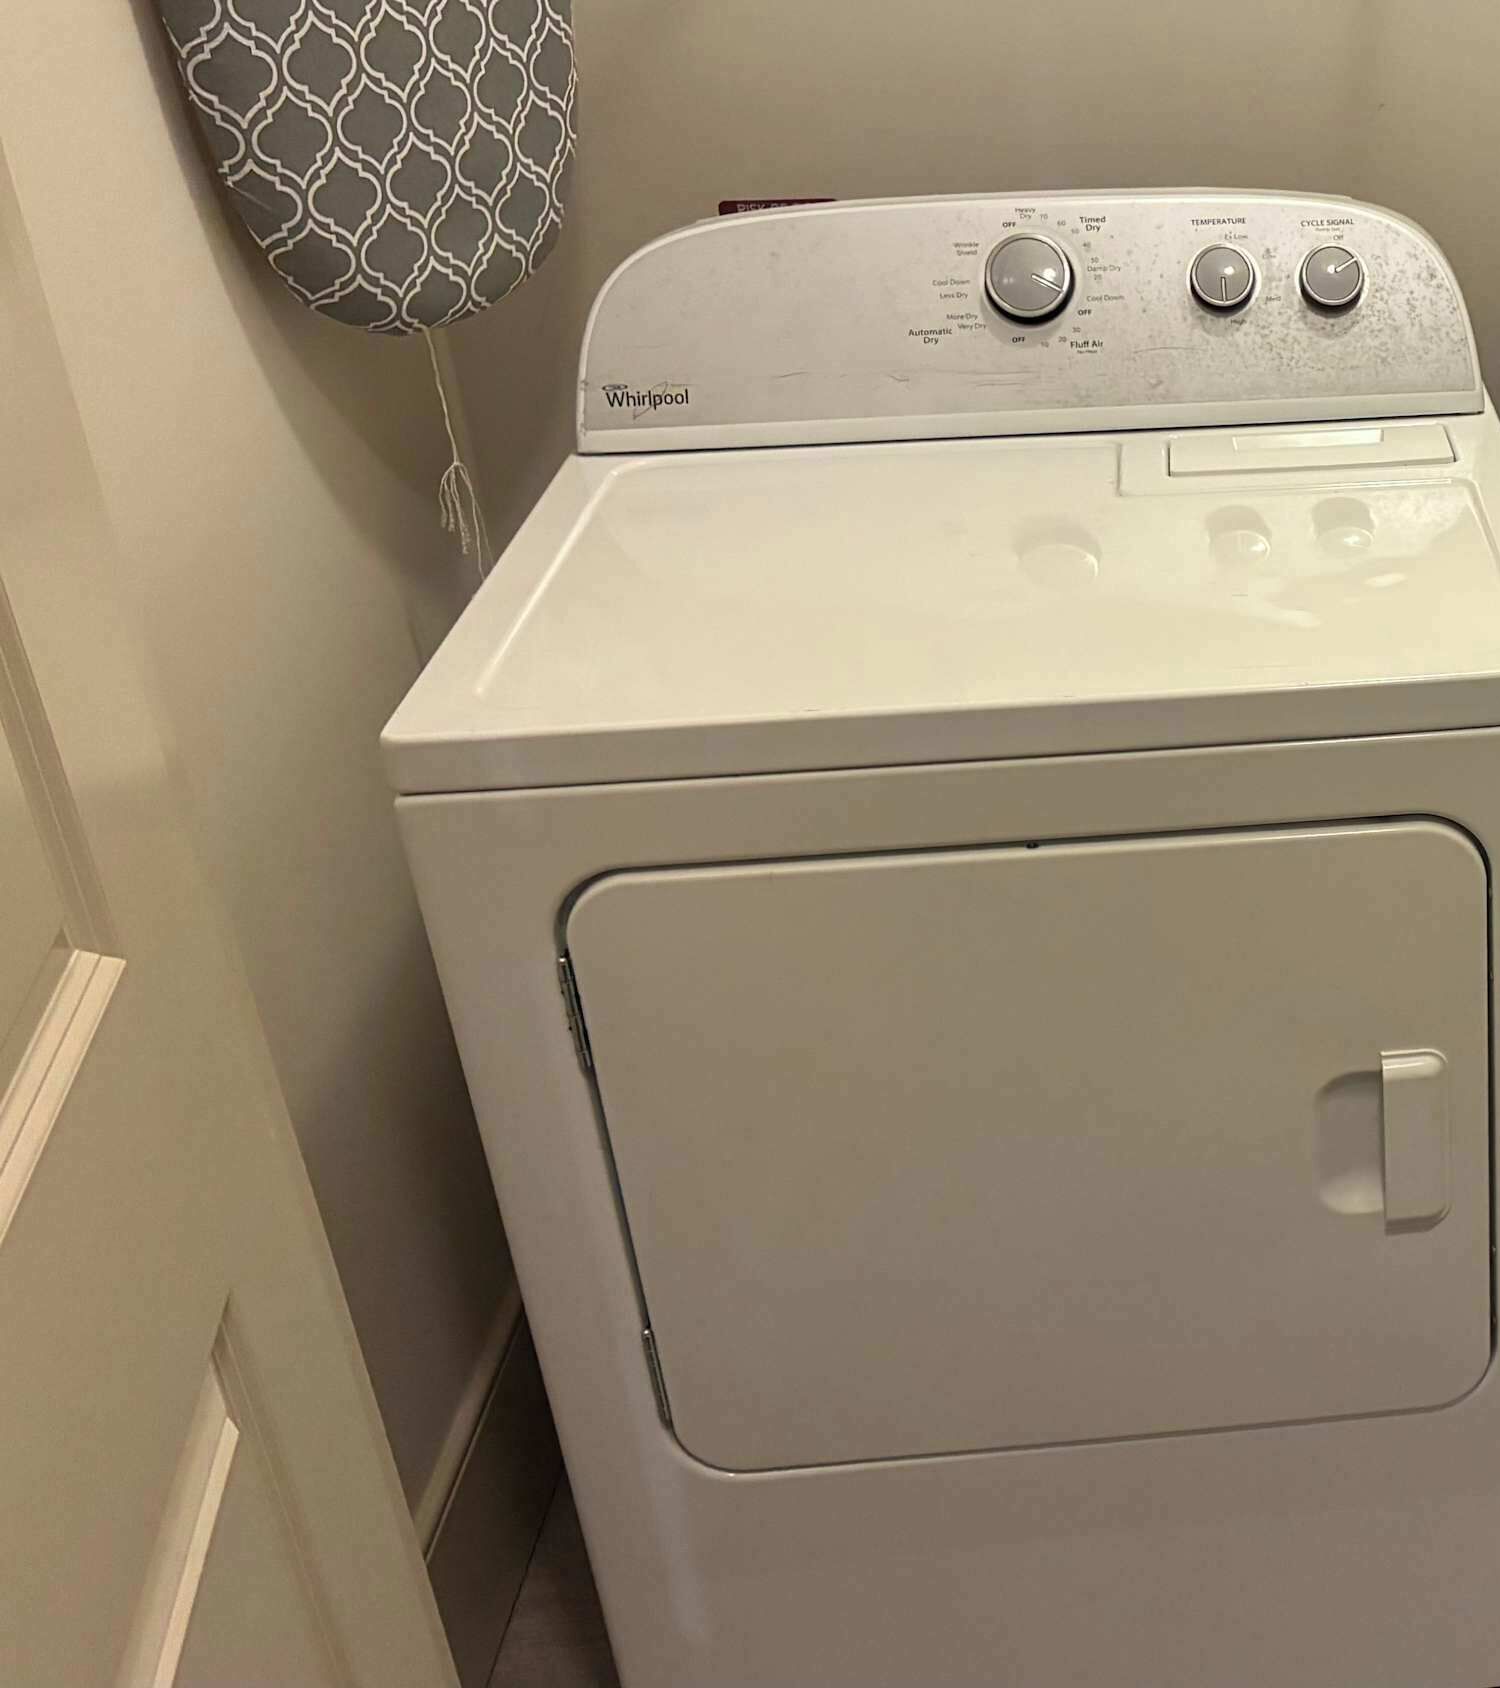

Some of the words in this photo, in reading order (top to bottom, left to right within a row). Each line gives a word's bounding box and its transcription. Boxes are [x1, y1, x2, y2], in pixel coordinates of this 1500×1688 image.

[1079, 216, 1107, 224] Timed
[1191, 217, 1247, 226] TEMPERATURE
[1300, 219, 1325, 228] CYCLE
[1326, 218, 1355, 226] SIGNAL
[1085, 223, 1102, 232] Dry
[908, 328, 953, 337] Automatic
[923, 336, 940, 345] Dry
[1070, 340, 1089, 349] Fluff
[1091, 339, 1104, 348] Air
[605, 388, 689, 411] Whirlpool
